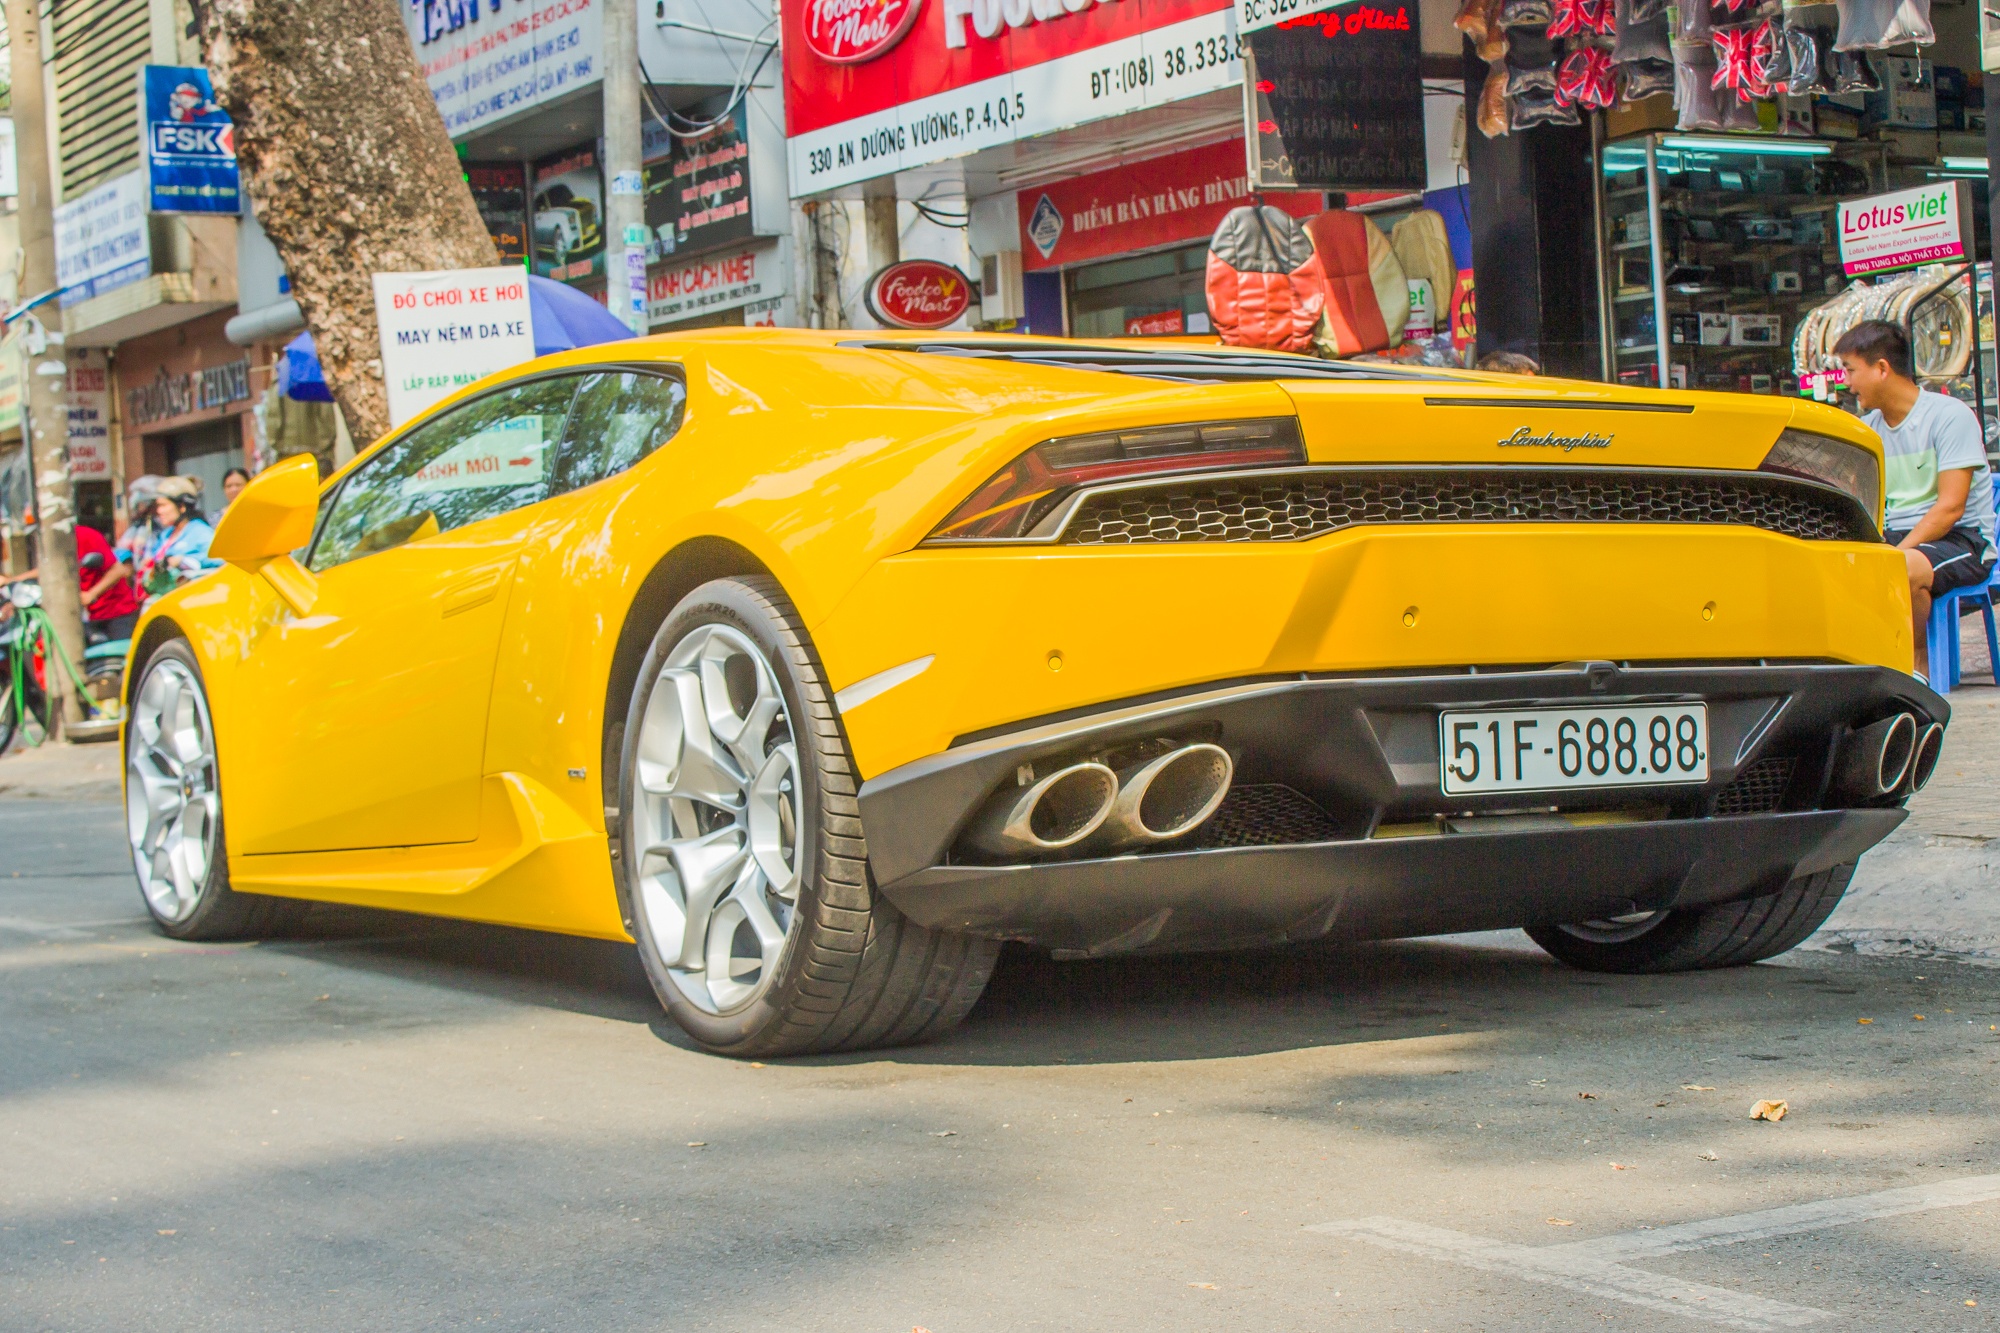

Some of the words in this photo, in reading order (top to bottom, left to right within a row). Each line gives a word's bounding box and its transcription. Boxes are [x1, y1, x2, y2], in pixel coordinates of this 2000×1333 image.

[829, 1, 902, 55] Mart
[157, 126, 217, 153] FSK
[810, 146, 832, 175] 330
[838, 140, 855, 168] AN
[861, 127, 905, 161] DƯƠNG
[1117, 194, 1150, 223] BÁN
[1153, 186, 1200, 215] HÀNG
[1204, 176, 1247, 204] BÌNH
[1844, 191, 1947, 234] Lotusviet
[1853, 262, 1870, 272] PHỤ
[1891, 256, 1898, 265] &
[423, 287, 463, 308] CHƠI
[469, 287, 488, 304] XE
[496, 283, 524, 301] HƠI
[901, 295, 962, 314] Mart
[397, 328, 431, 345] MAY
[438, 323, 473, 344] NỆM
[479, 323, 500, 339] DA
[506, 321, 525, 336] XE
[1498, 426, 1614, 452] Lamborghini
[1453, 714, 1698, 782] 51F-688.88
